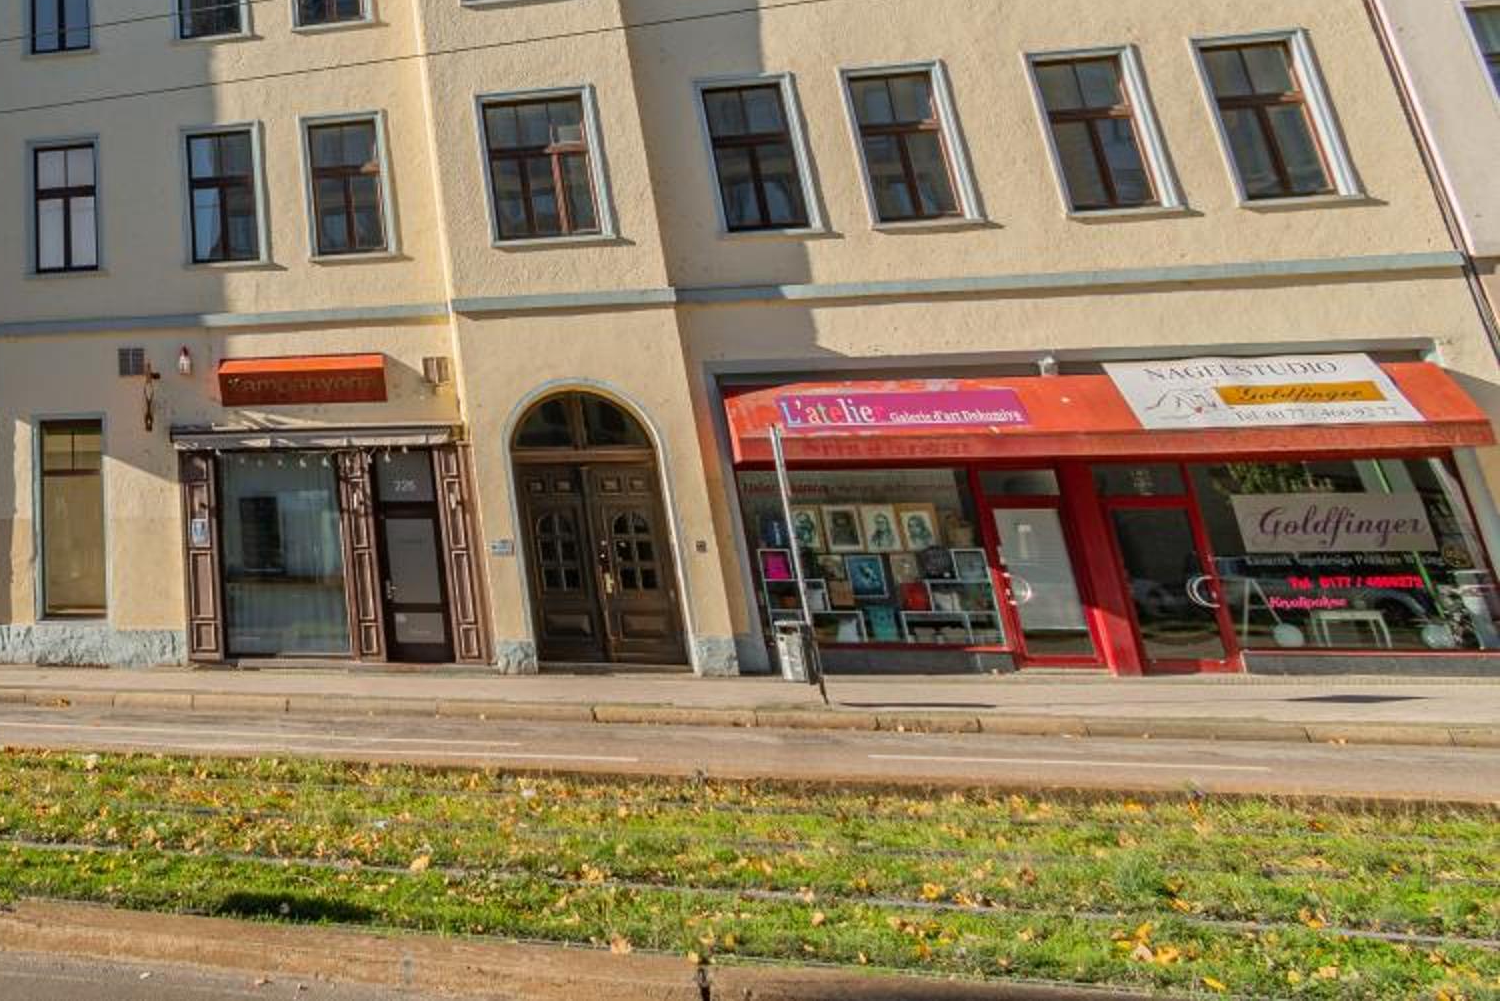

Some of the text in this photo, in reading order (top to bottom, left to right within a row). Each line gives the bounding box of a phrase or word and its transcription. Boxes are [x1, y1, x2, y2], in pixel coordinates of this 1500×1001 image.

[1143, 360, 1338, 380] NAGELSTUDIO
[1235, 385, 1364, 402] Goldfinger
[1257, 505, 1428, 547] Goldfinger
